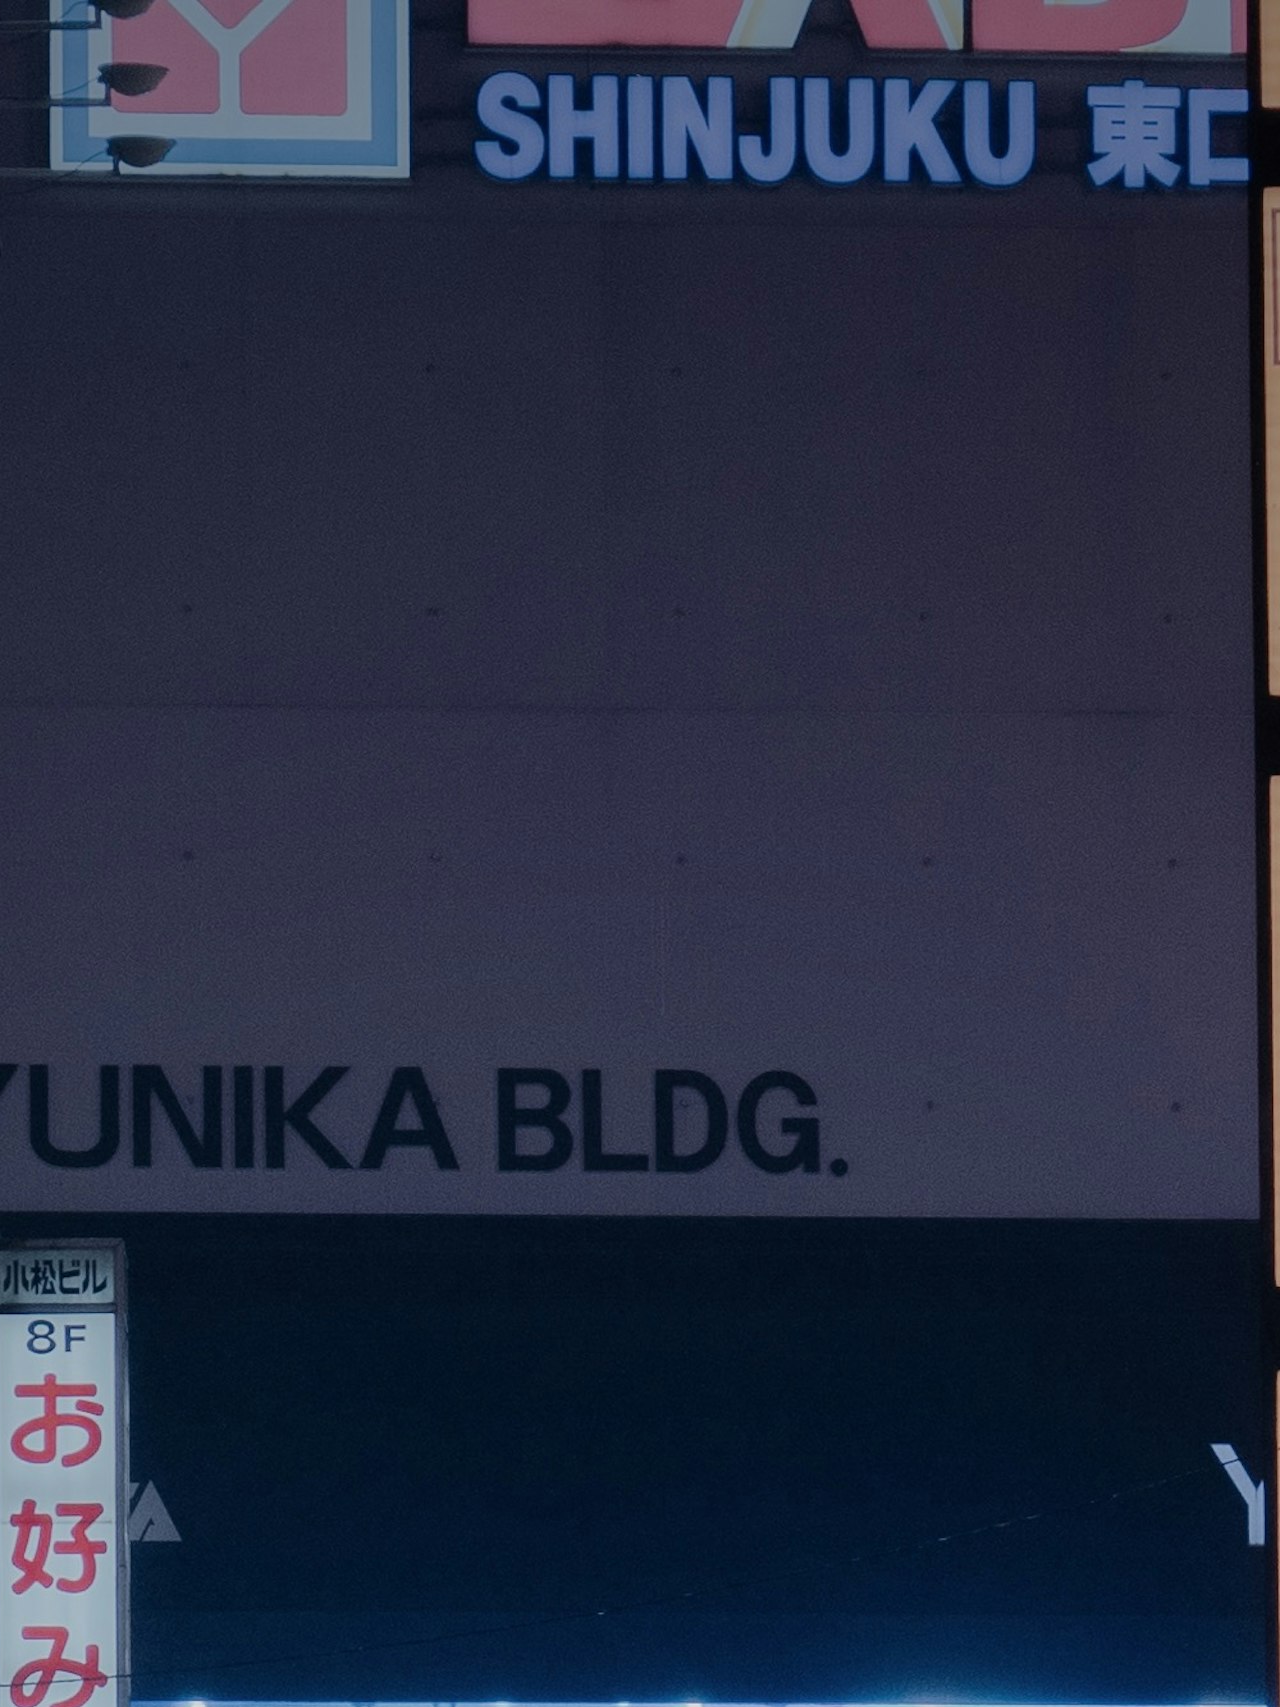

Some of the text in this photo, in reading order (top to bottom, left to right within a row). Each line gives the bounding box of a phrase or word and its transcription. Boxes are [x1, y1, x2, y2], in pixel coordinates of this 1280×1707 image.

[472, 70, 1038, 187] SHINJUKU
[494, 1068, 850, 1180] BLDG.
[3, 1259, 109, 1297] 小松ビル
[25, 1319, 88, 1354] 8F
